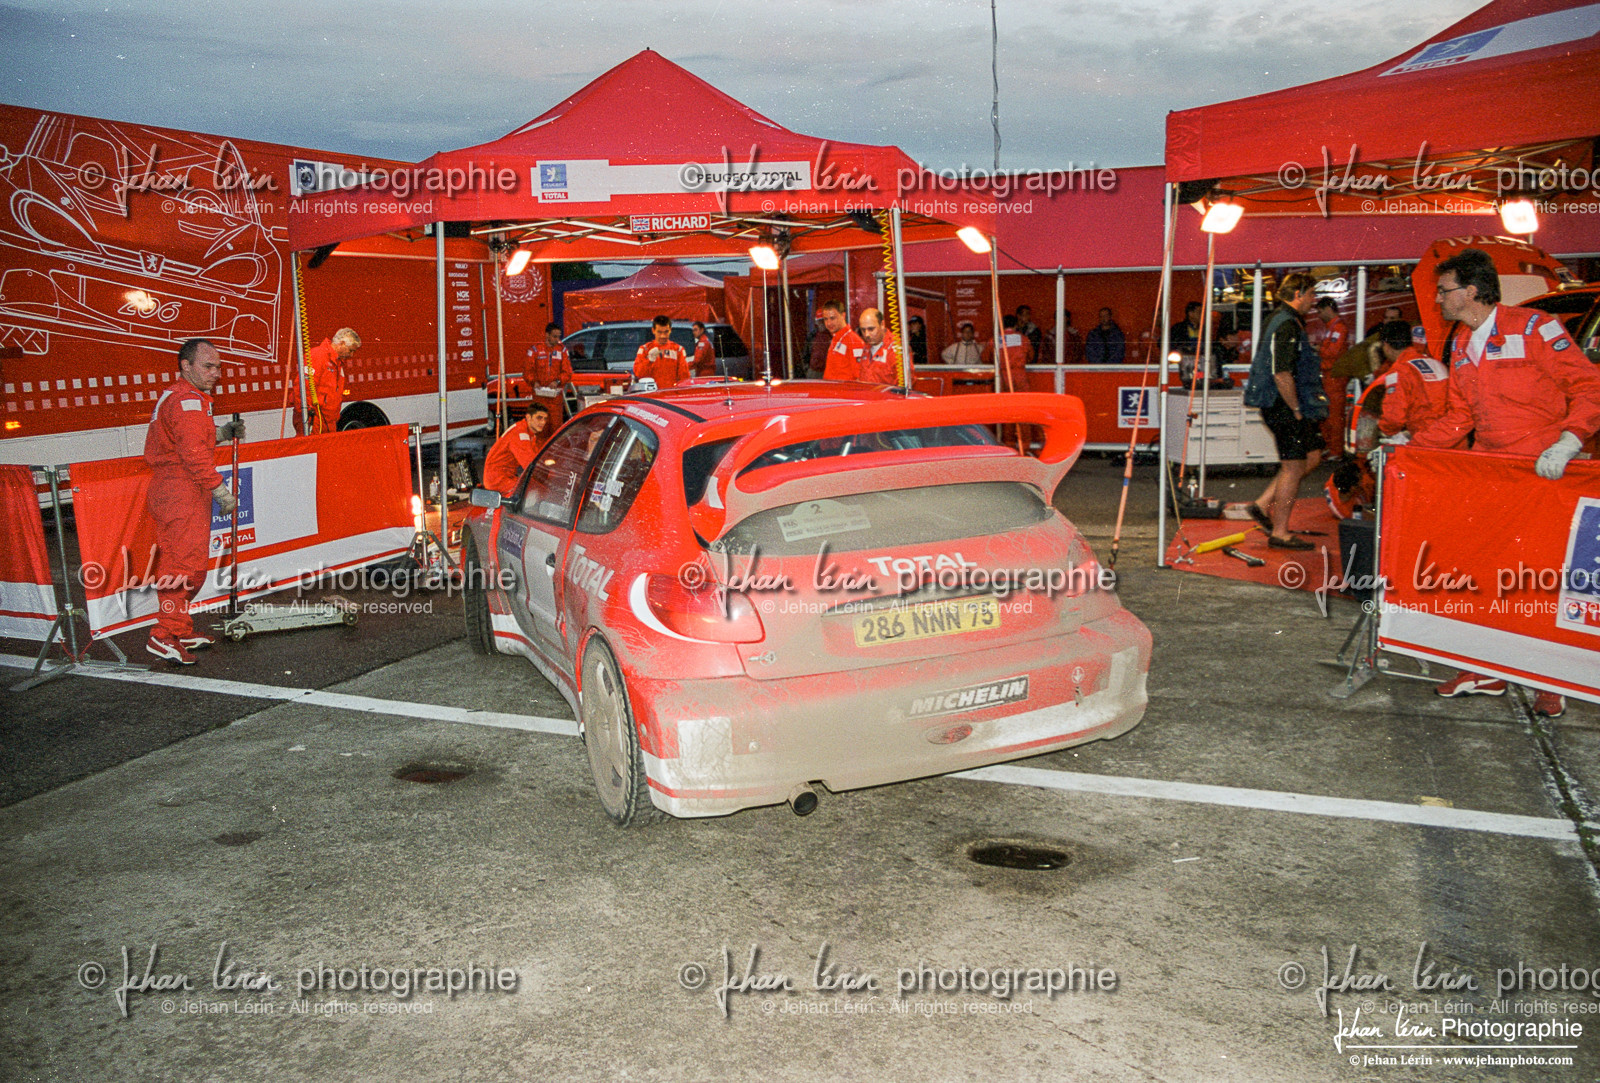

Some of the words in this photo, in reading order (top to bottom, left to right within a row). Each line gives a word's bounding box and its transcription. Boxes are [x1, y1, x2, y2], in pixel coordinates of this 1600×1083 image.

[697, 172, 758, 184] PEUGEOT
[652, 216, 708, 230] RICHARD
[810, 503, 823, 515] 2
[568, 544, 615, 602] TOTAL
[867, 552, 978, 577] TOTAL
[862, 613, 906, 643] 286
[912, 604, 962, 635] NNN
[968, 601, 995, 627] 75
[909, 680, 1027, 715] MICHELIN
